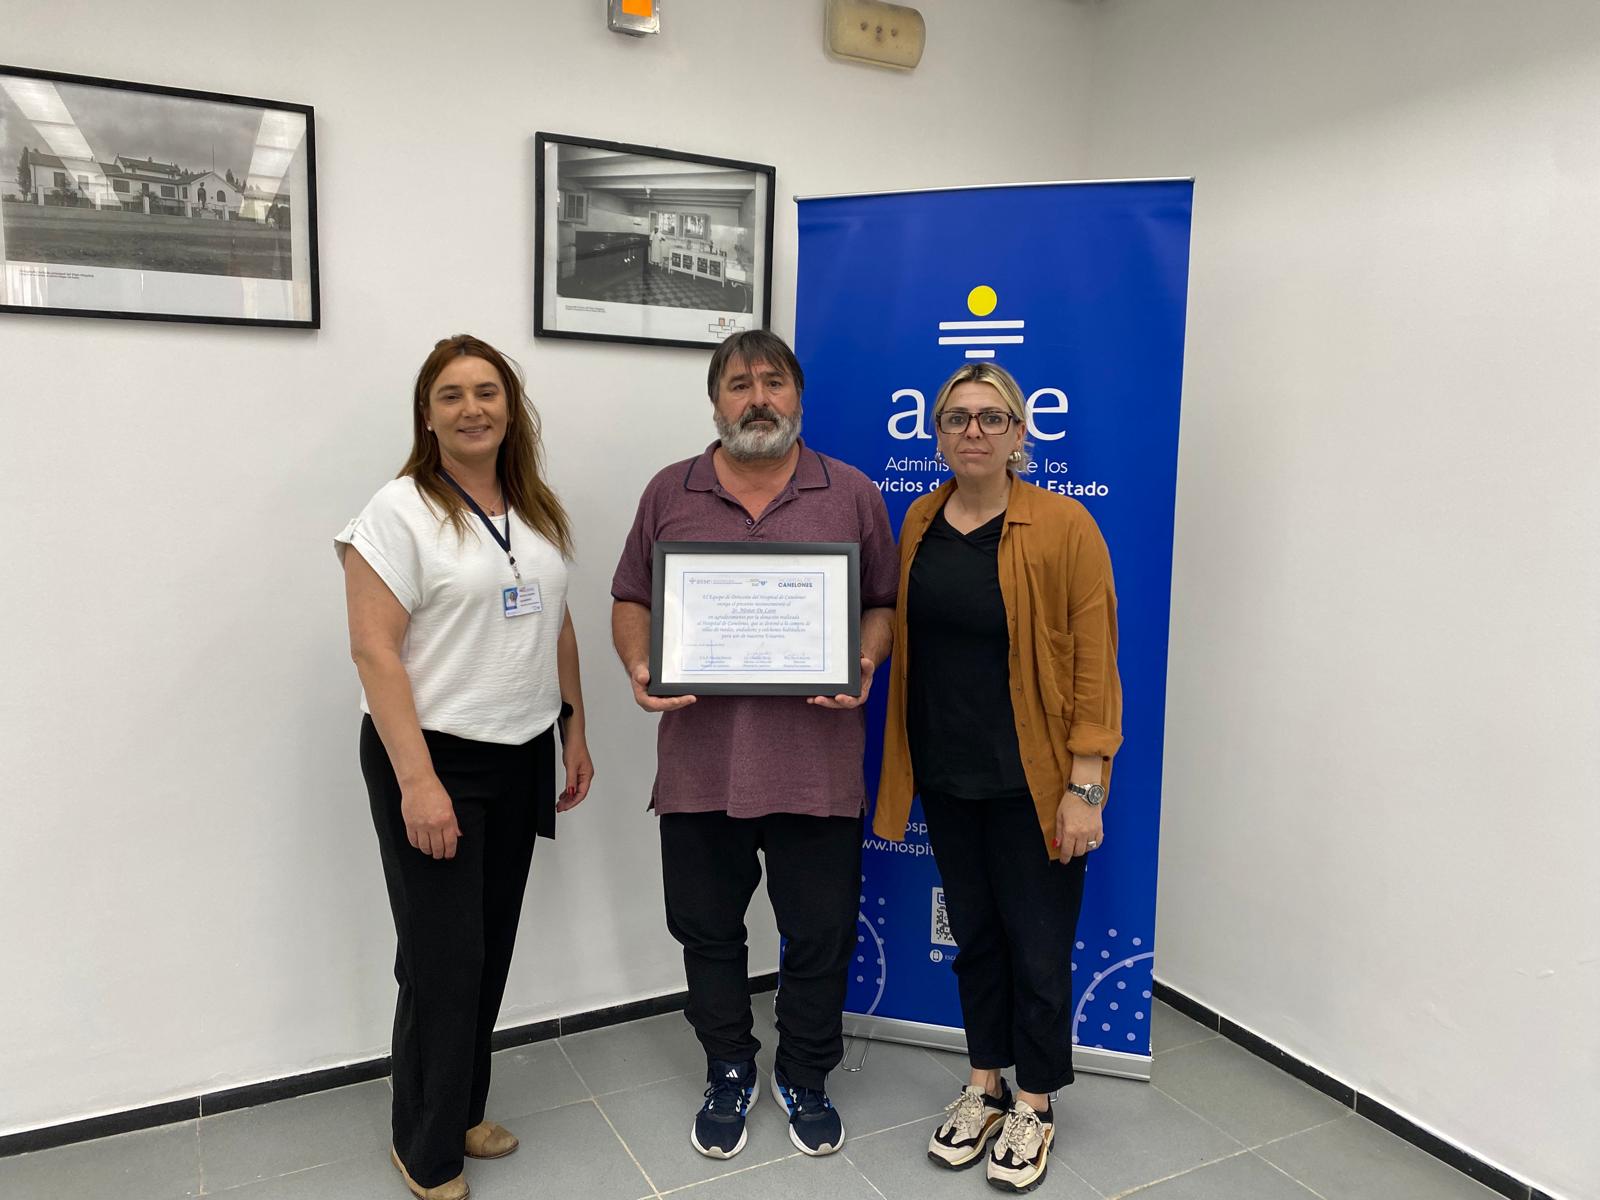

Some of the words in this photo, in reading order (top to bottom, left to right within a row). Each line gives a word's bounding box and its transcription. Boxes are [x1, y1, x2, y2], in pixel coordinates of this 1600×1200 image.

[887, 387, 1069, 441] ae
[885, 457, 949, 472] Adminis
[1044, 458, 1068, 473] los
[872, 478, 923, 492] vicios
[1047, 481, 1109, 496] Estado
